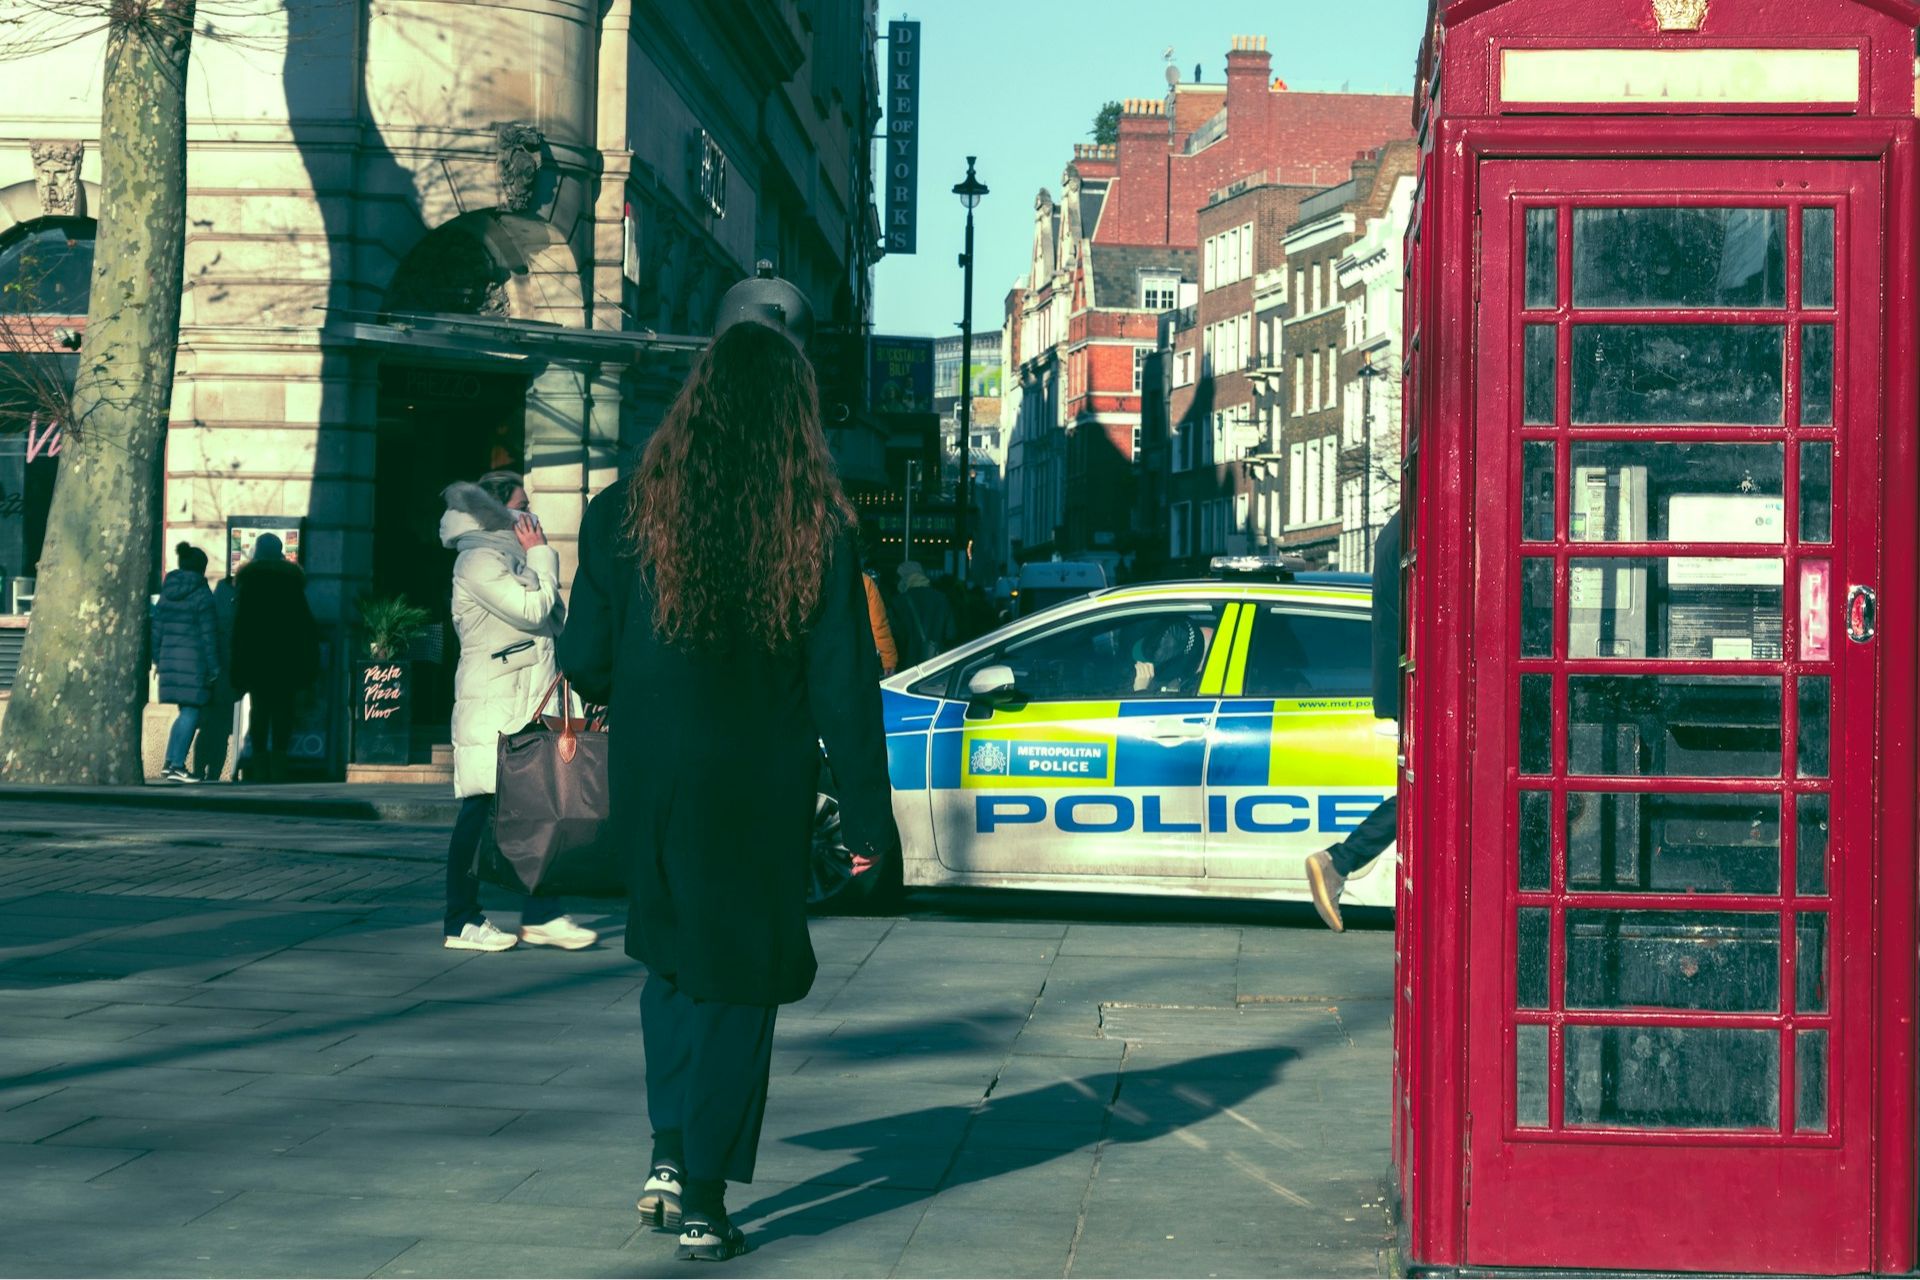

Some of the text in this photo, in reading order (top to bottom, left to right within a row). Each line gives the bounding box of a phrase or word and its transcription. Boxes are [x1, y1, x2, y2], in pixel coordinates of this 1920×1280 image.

[889, 27, 914, 248] DUKE OF YORK'S
[889, 363, 911, 377] BILLY
[364, 664, 402, 684] Pasta
[364, 683, 401, 702] Pizza
[364, 703, 400, 721] Vino
[1298, 700, 1374, 708] www.met.po
[1017, 746, 1101, 758] METROPOLITAN
[1029, 759, 1089, 773] POLICE
[976, 795, 1384, 834] POLICE
